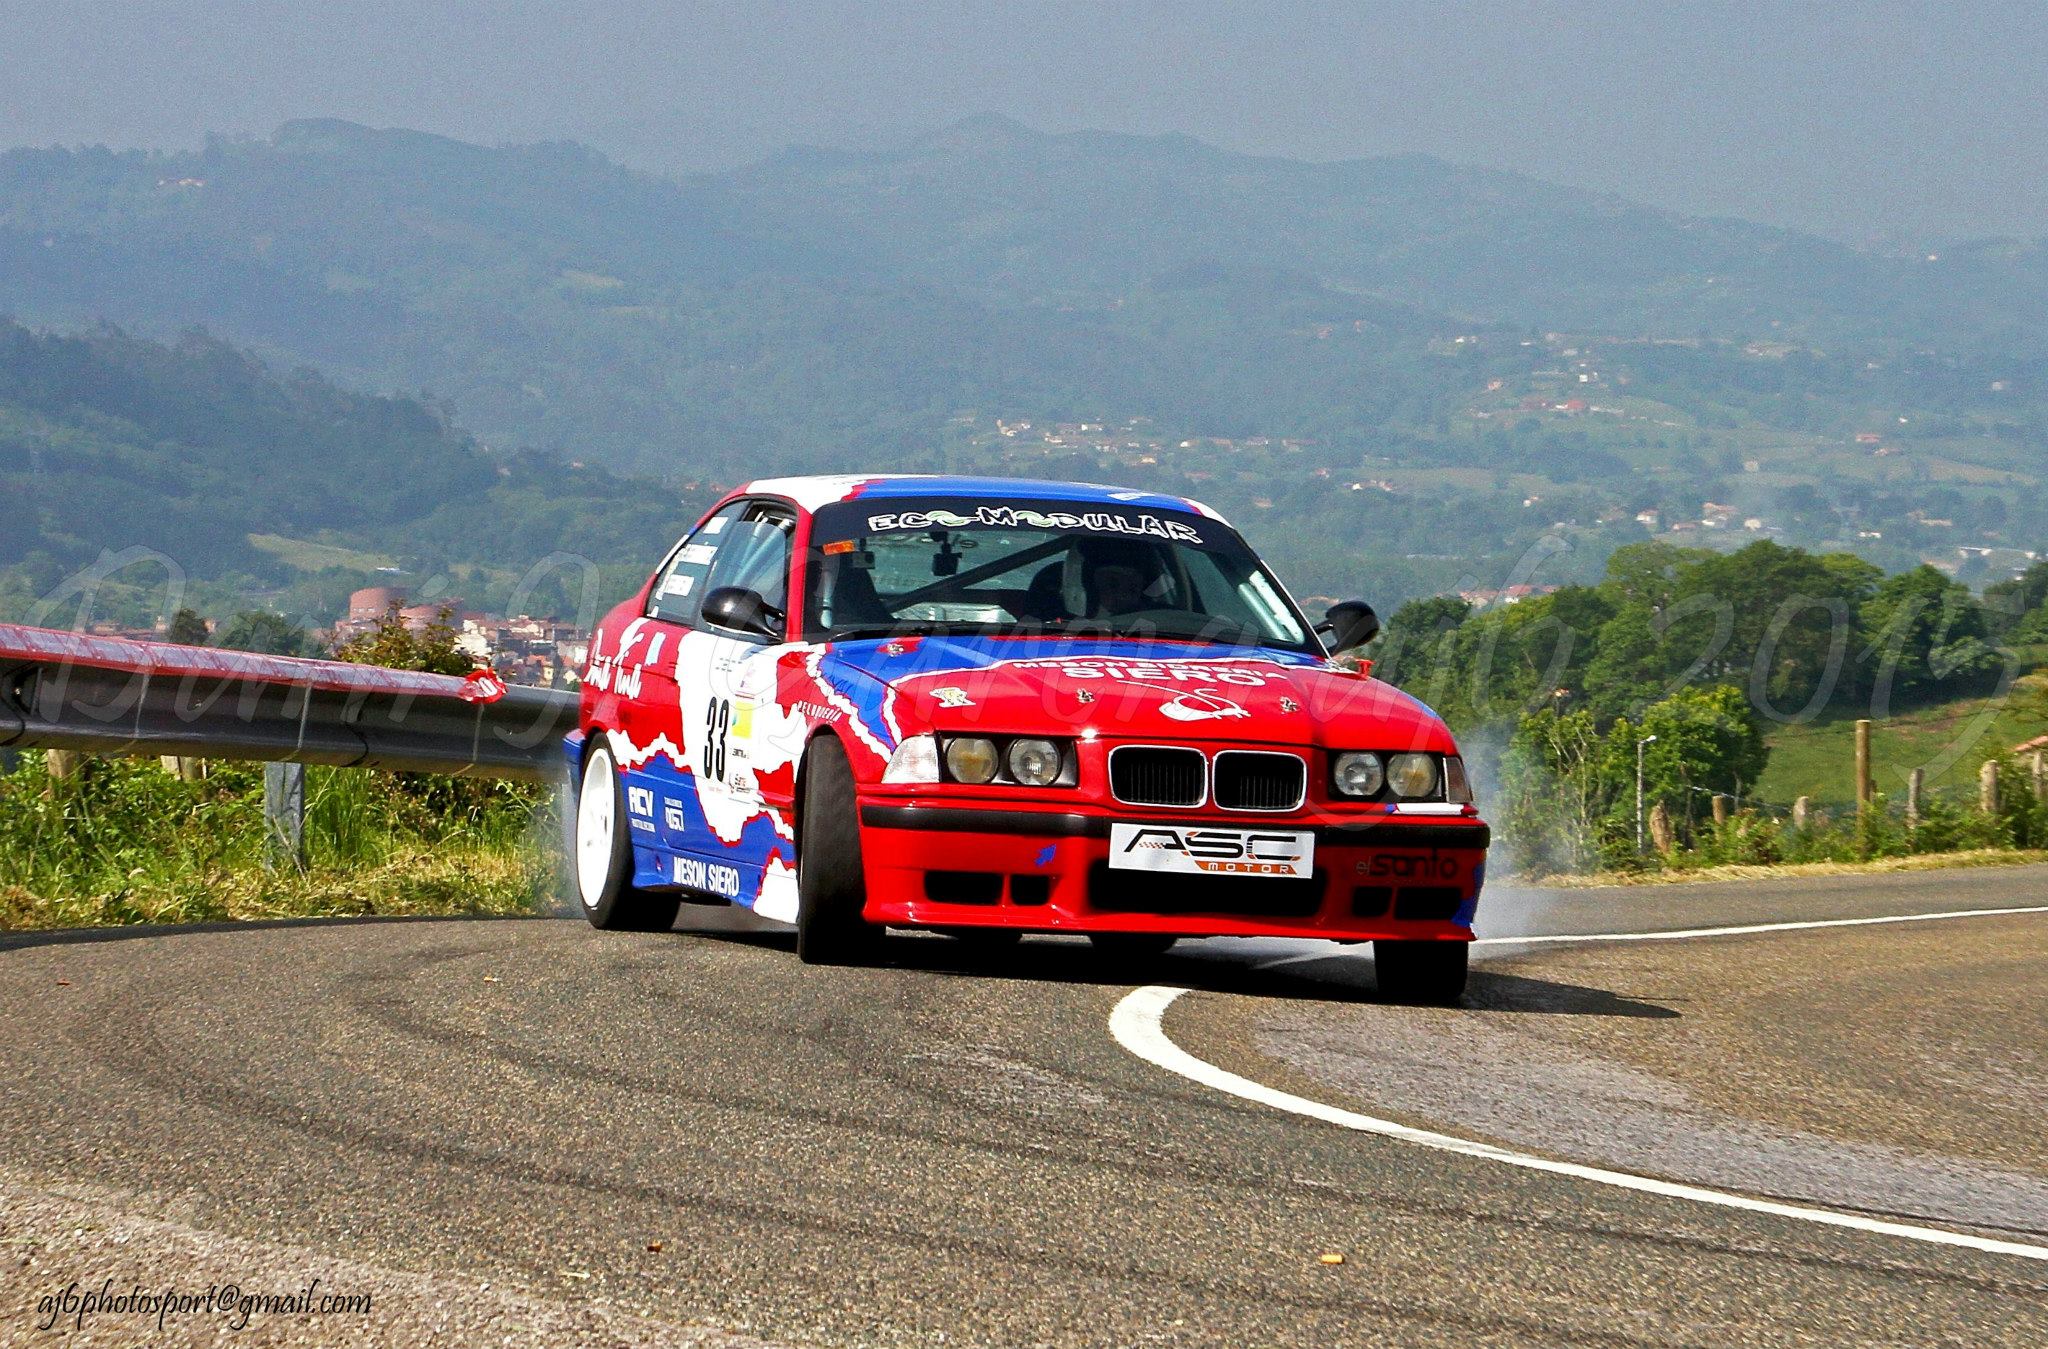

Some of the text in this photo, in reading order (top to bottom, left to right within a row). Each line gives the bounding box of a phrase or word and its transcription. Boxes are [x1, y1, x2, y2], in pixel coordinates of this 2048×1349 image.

[1061, 667, 1266, 686] SIERO
[704, 696, 729, 782] 33
[1123, 828, 1301, 862] ASC
[673, 857, 740, 897] MESON SIERO
[1207, 861, 1289, 874] MOTOR
